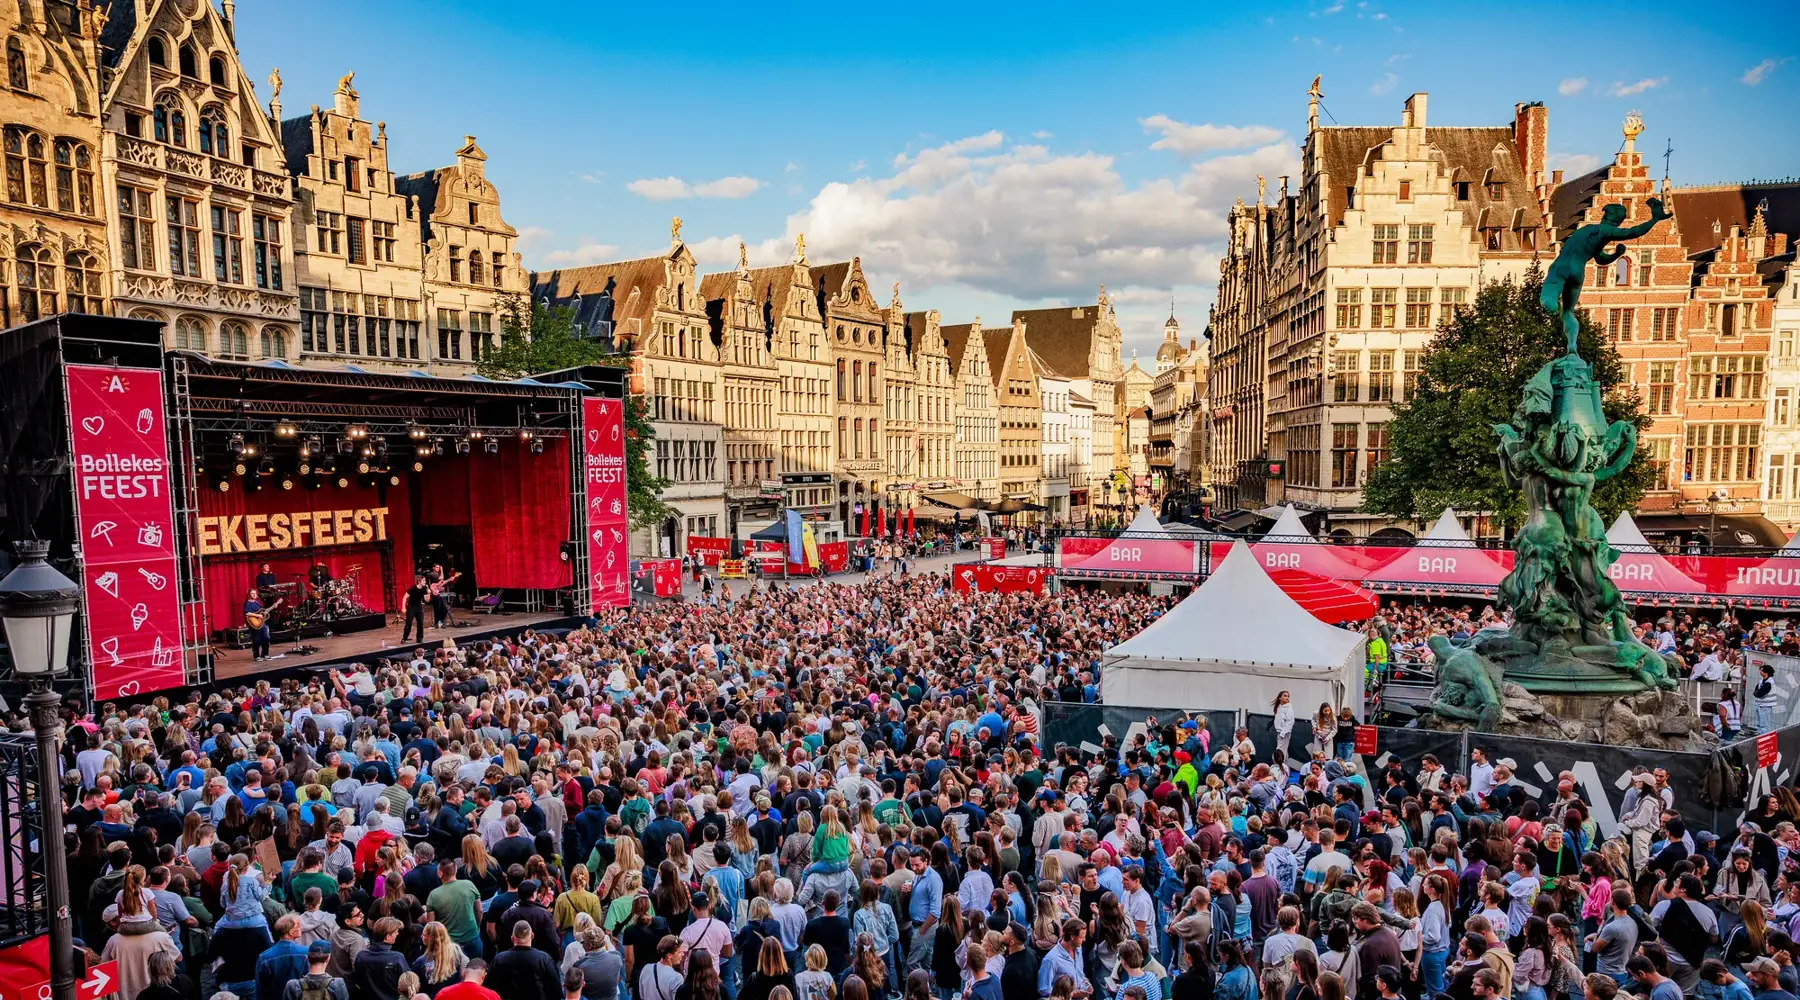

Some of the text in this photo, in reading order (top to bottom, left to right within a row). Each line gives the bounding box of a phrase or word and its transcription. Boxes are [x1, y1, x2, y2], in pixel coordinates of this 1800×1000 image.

[81, 453, 162, 473] Bollekes
[588, 454, 622, 466] Bollekes
[588, 467, 622, 483] FEEST
[82, 475, 163, 499] FEEST
[192, 507, 389, 554] EKESFEEST
[1110, 547, 1142, 562] BAR
[1266, 552, 1300, 568] BAR
[1418, 556, 1457, 573] BAR
[1610, 563, 1654, 581] BAR
